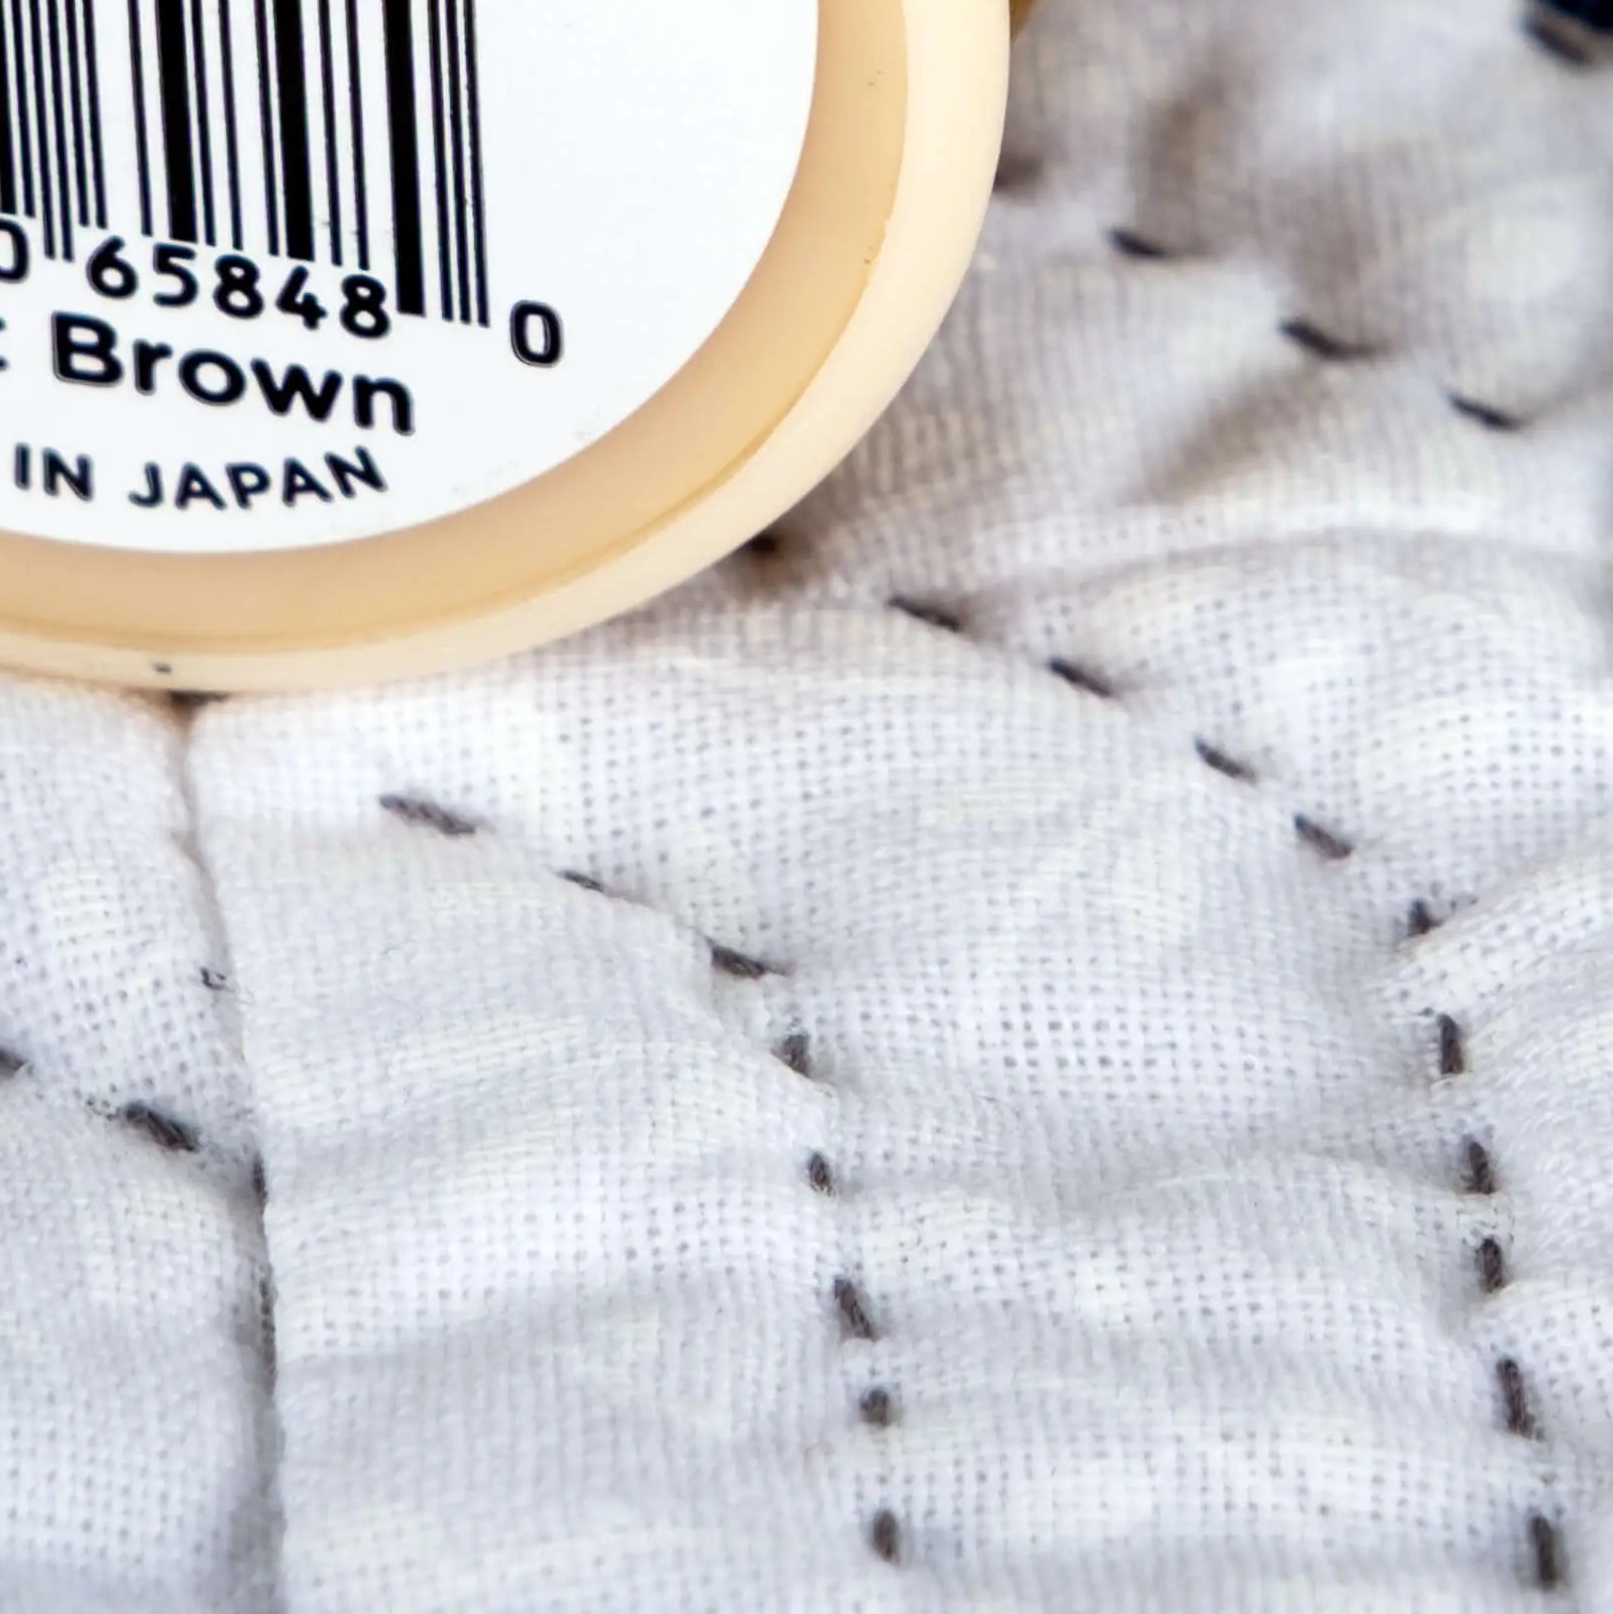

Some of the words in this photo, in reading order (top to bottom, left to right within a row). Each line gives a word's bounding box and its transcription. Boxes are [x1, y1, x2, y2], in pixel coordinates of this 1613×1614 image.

[85, 235, 392, 341] 65848
[50, 311, 414, 437] Brown
[14, 444, 93, 502] IN
[129, 446, 386, 511] JAPAN
